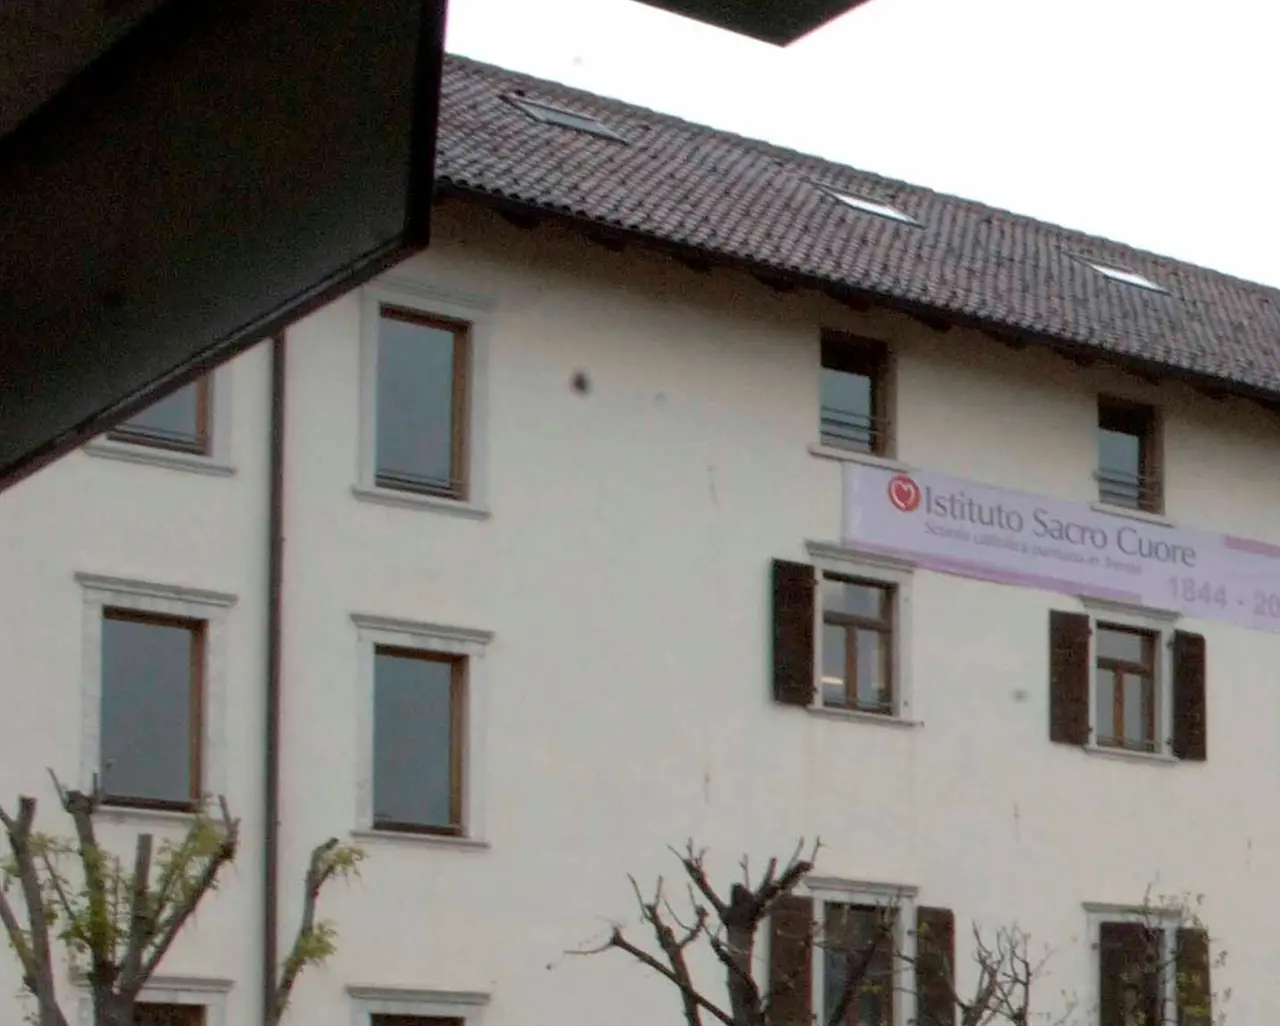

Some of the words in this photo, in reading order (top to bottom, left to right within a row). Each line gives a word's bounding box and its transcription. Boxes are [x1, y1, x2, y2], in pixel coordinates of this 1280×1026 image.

[924, 485, 1024, 534] Istituto
[1032, 506, 1108, 549] Sacro
[1117, 526, 1197, 568] Cuore
[1168, 574, 1227, 609] 1844
